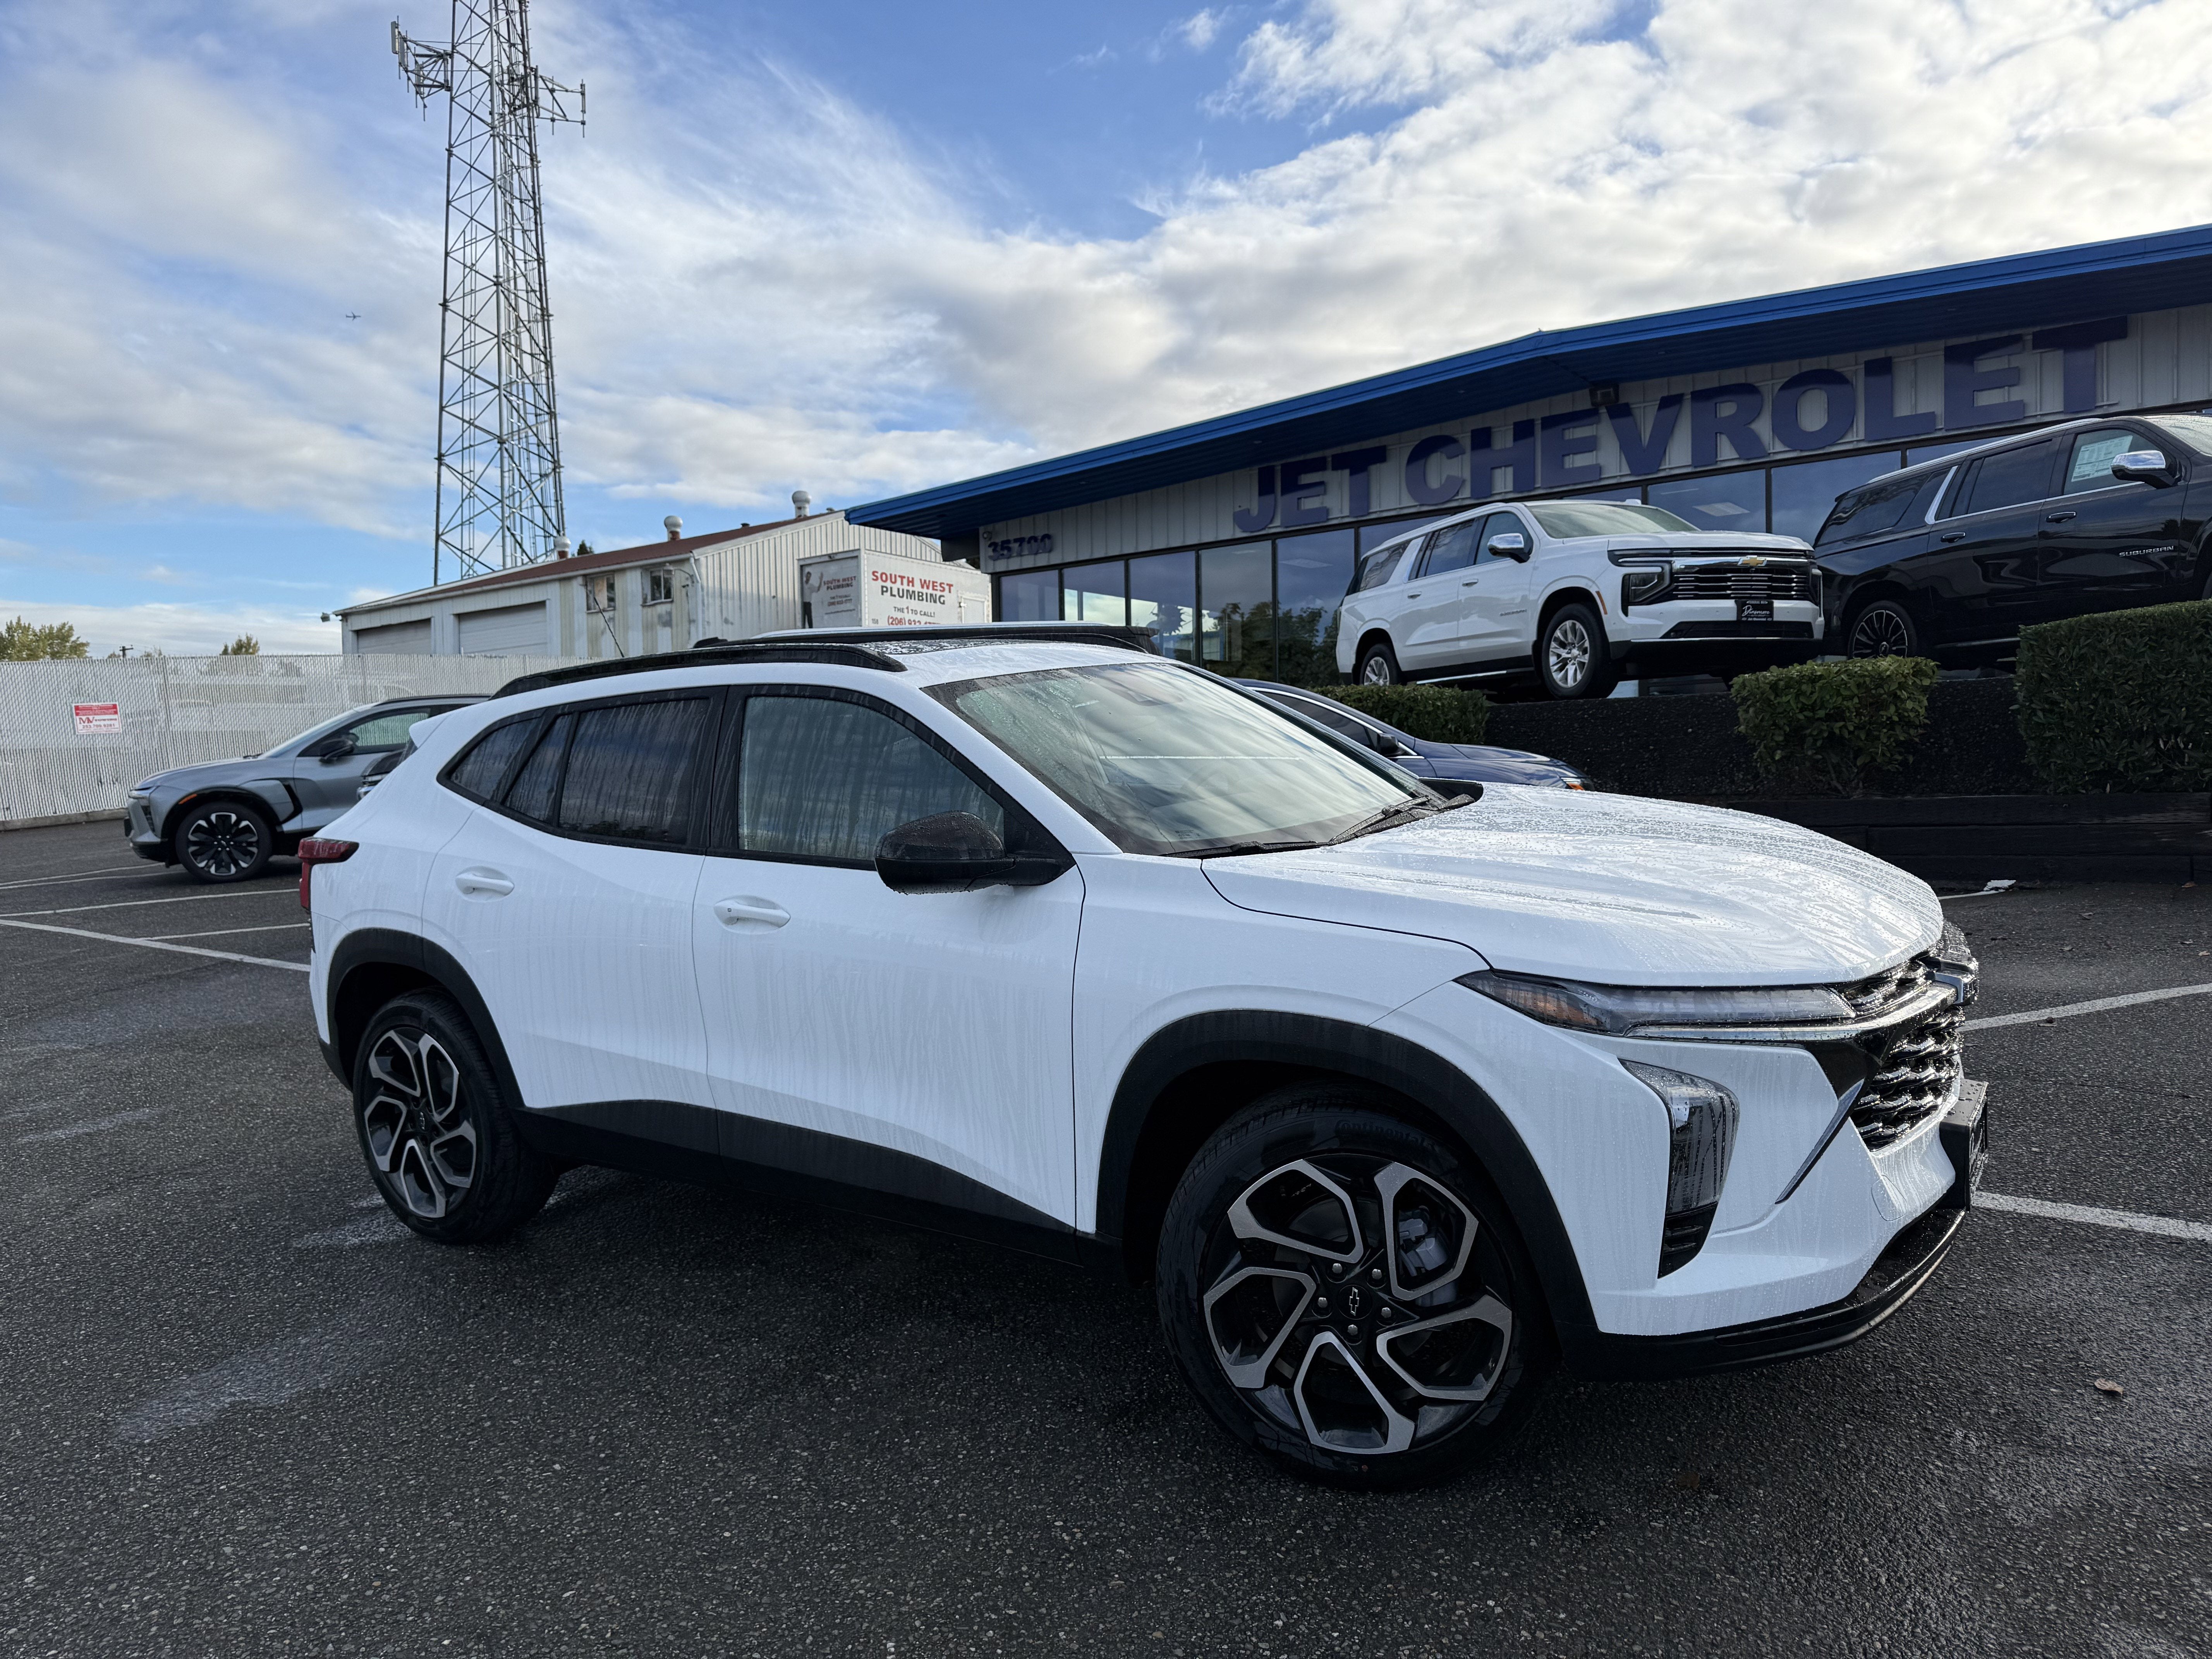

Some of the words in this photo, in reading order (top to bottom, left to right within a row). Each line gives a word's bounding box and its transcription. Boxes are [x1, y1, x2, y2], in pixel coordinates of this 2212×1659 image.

[1233, 445, 1386, 532] JET
[1405, 316, 2128, 505] CHEVROLET
[988, 534, 1053, 561] 35700
[2119, 546, 2173, 557] SUBURBAN
[872, 570, 914, 587] SOUTH
[919, 579, 953, 593] WEST
[881, 585, 946, 605] PLUMBING
[887, 615, 906, 625] (206)
